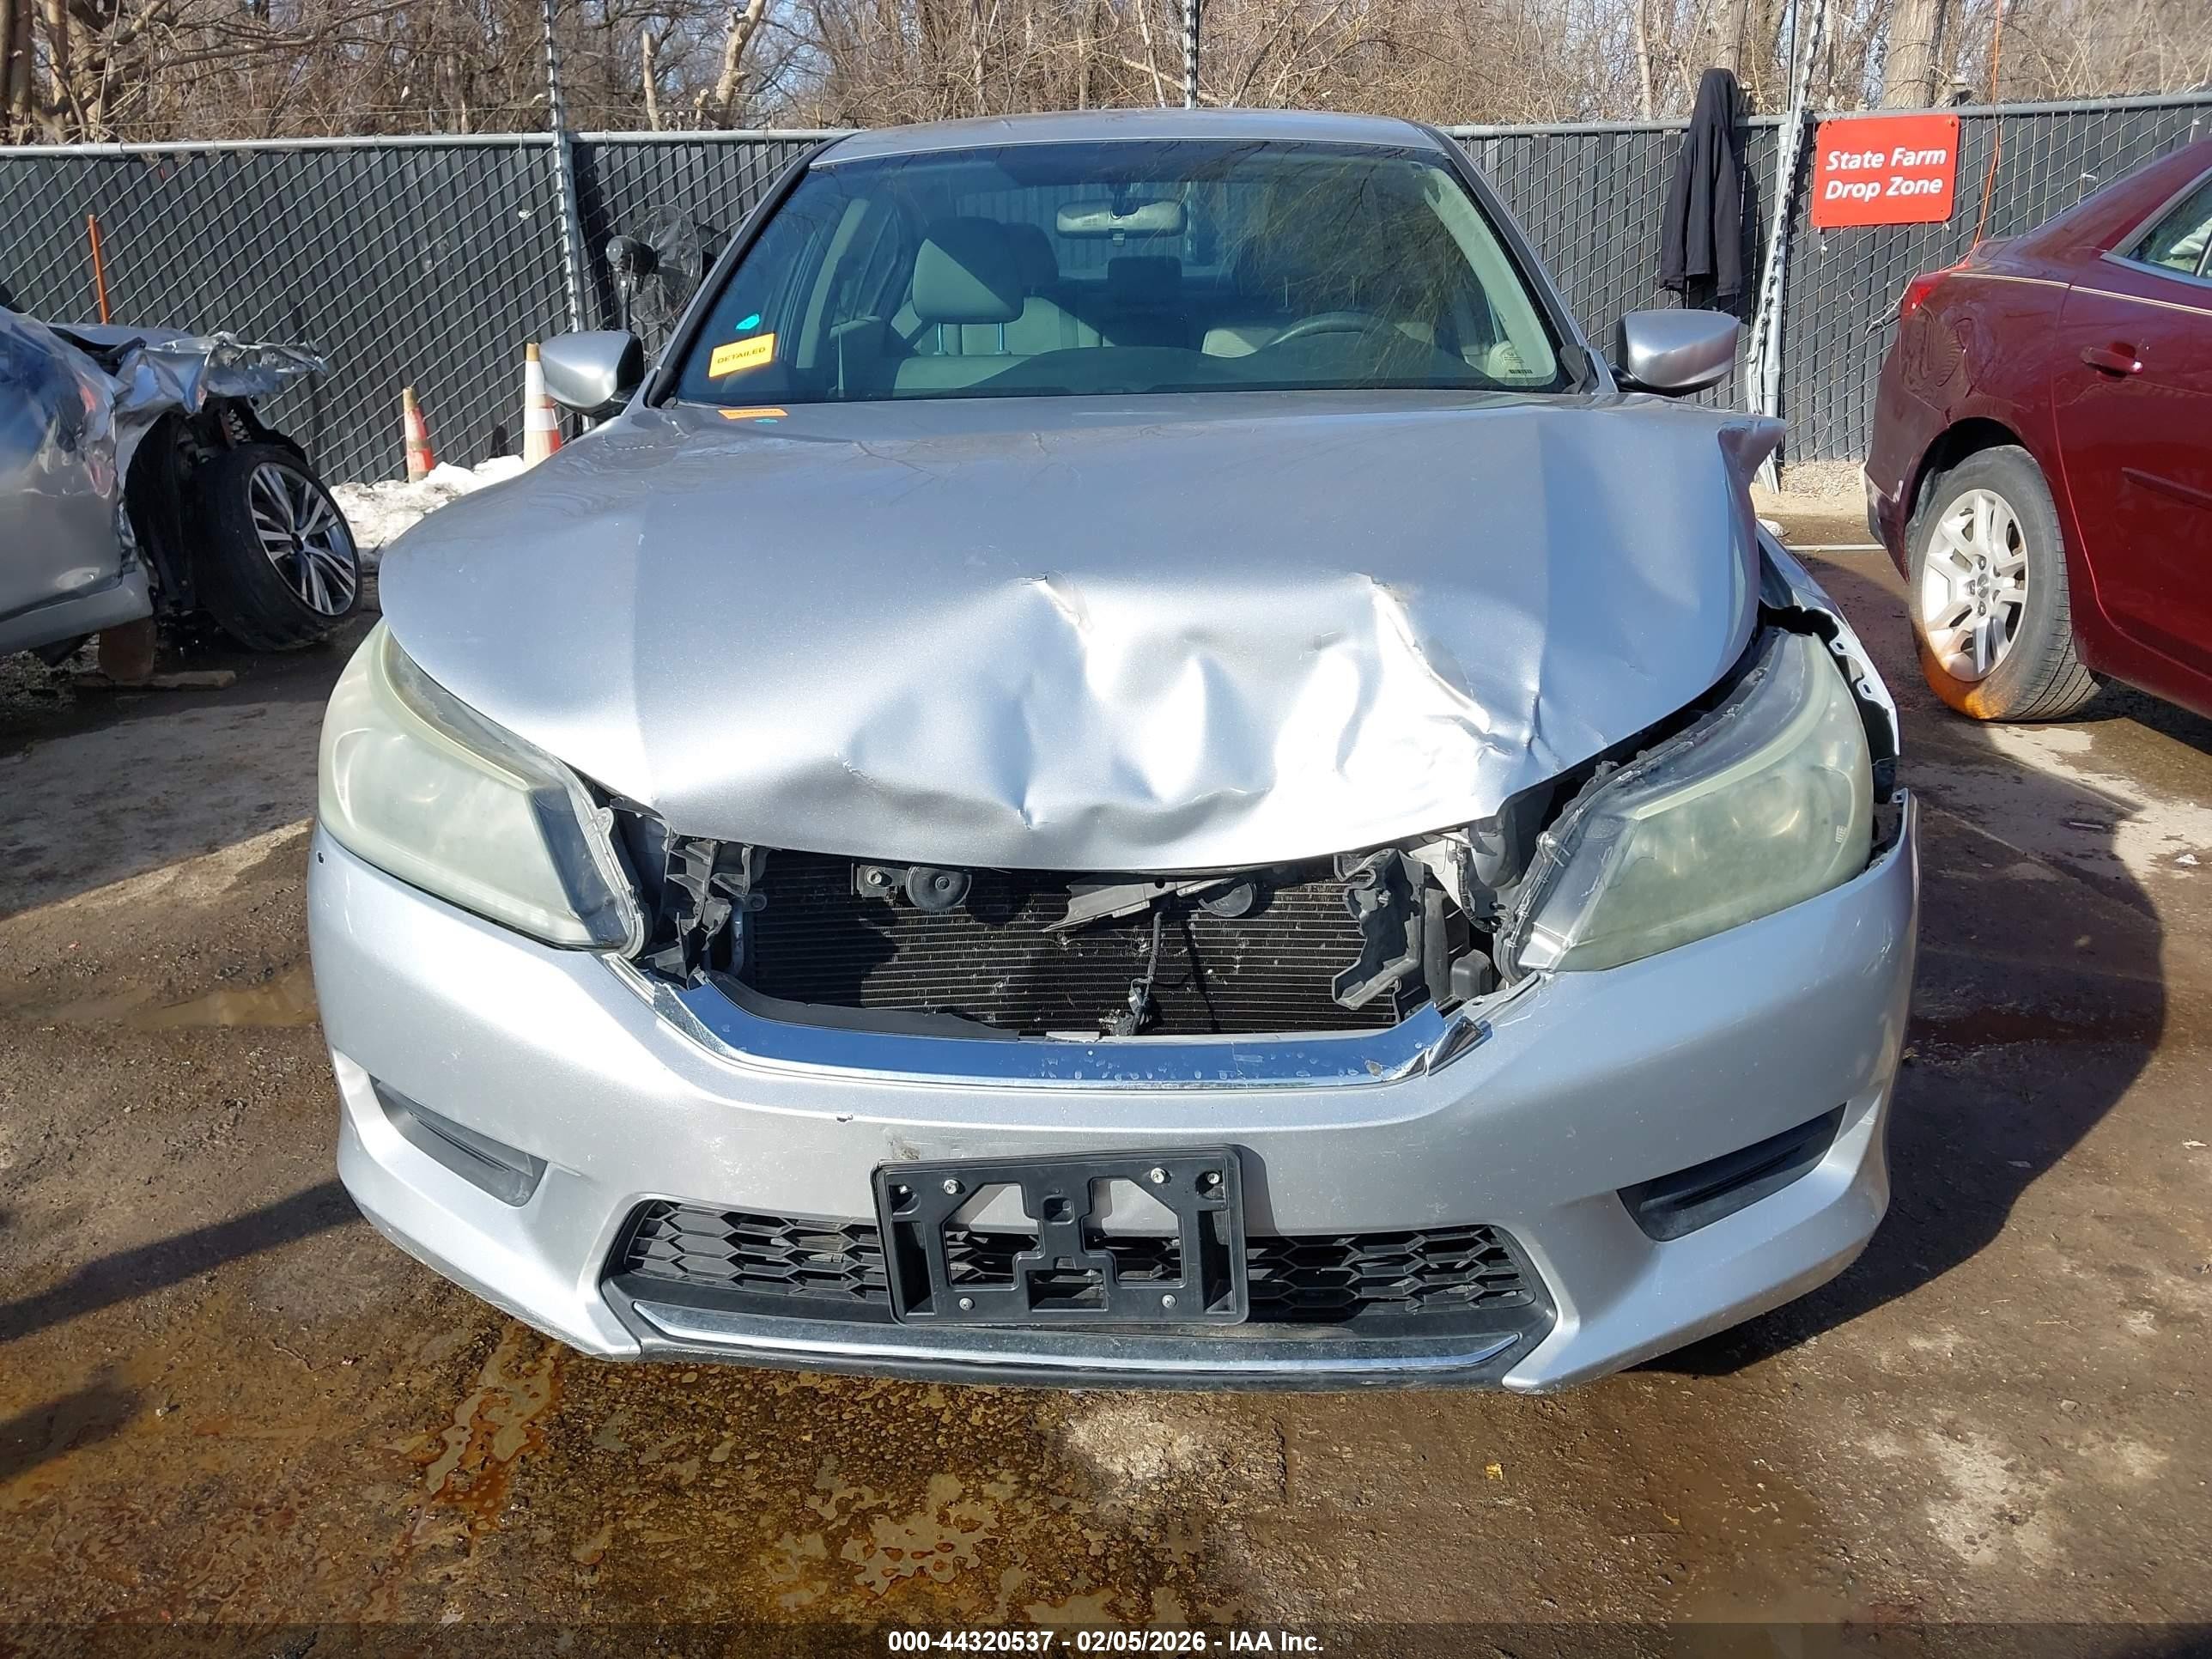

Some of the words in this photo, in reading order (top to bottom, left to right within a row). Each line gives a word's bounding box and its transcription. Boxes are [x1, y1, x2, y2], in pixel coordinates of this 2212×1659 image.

[1825, 150, 1885, 171] State
[1890, 147, 1947, 167] Farm
[1825, 179, 1881, 203] Drop
[1885, 176, 1943, 197] Zone
[717, 346, 767, 364] DETAILED
